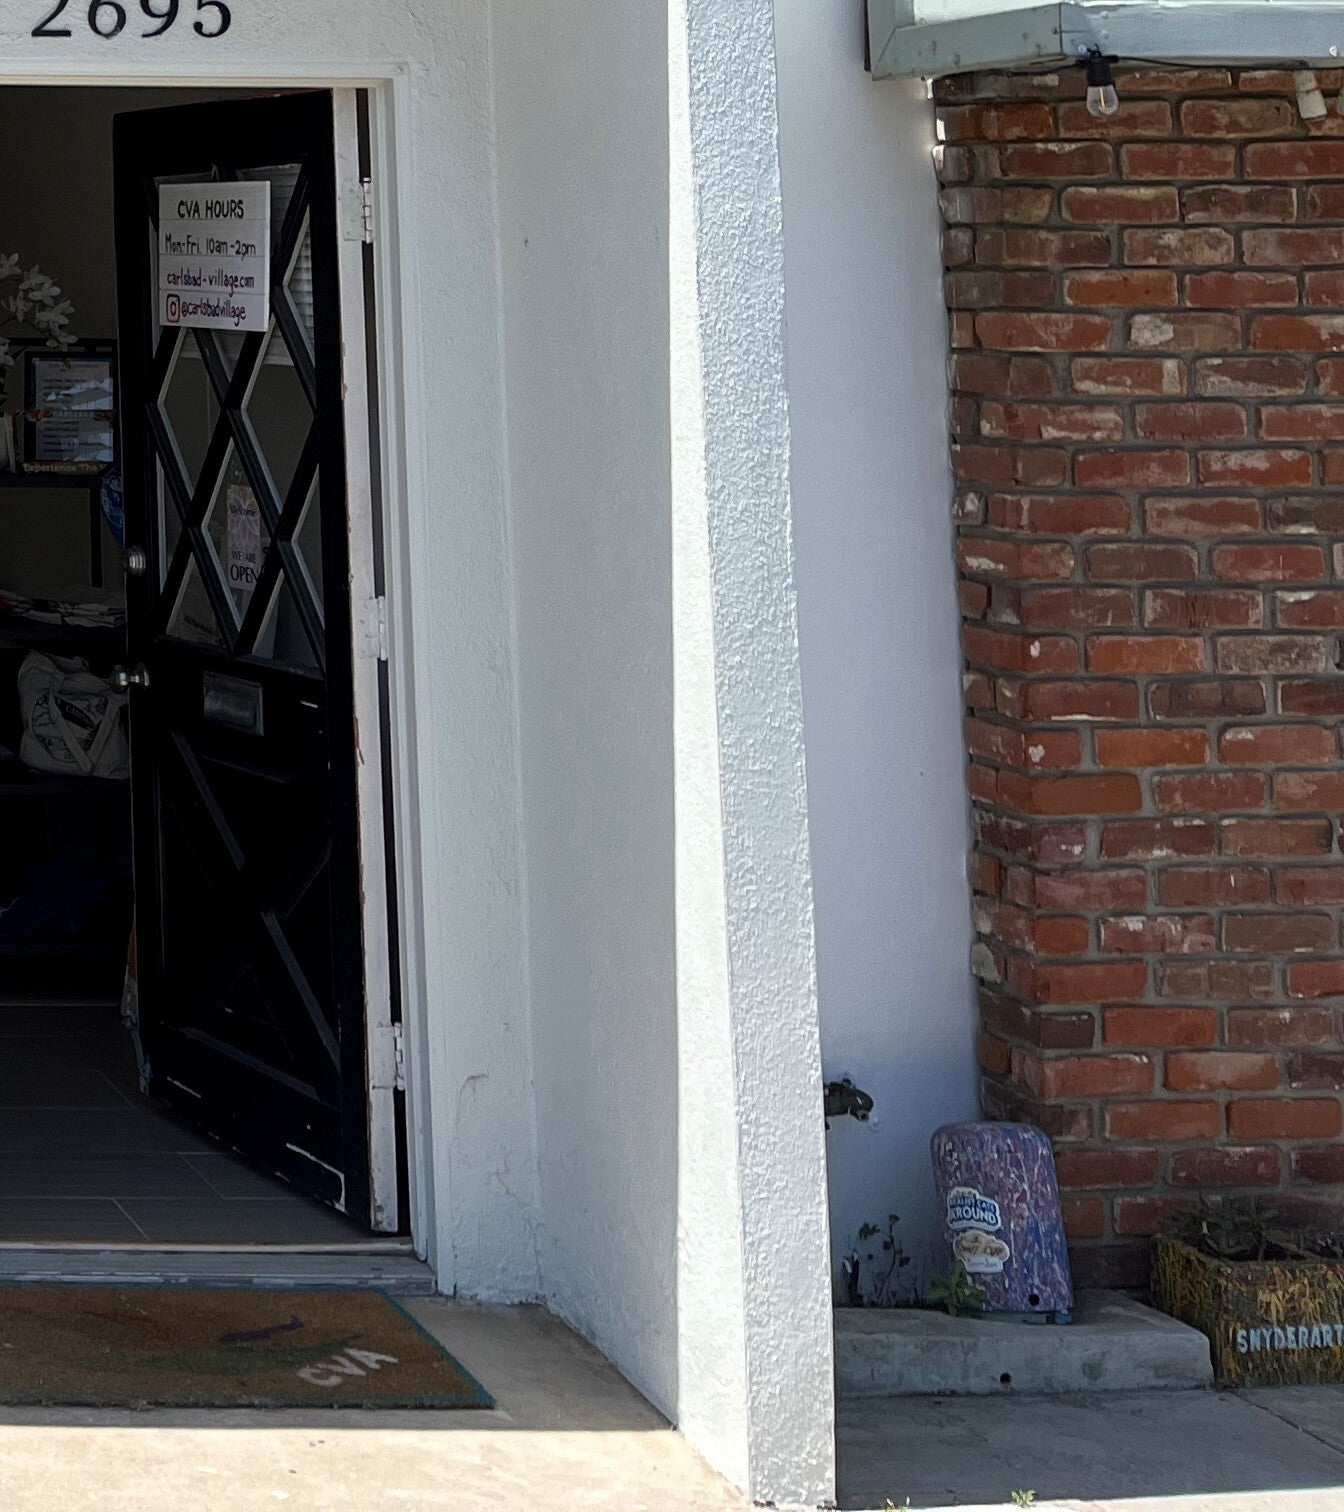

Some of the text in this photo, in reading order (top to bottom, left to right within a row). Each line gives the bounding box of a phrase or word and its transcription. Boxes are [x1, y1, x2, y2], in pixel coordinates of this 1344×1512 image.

[177, 199, 245, 220] CVA HOURS
[296, 1348, 400, 1387] CVA
